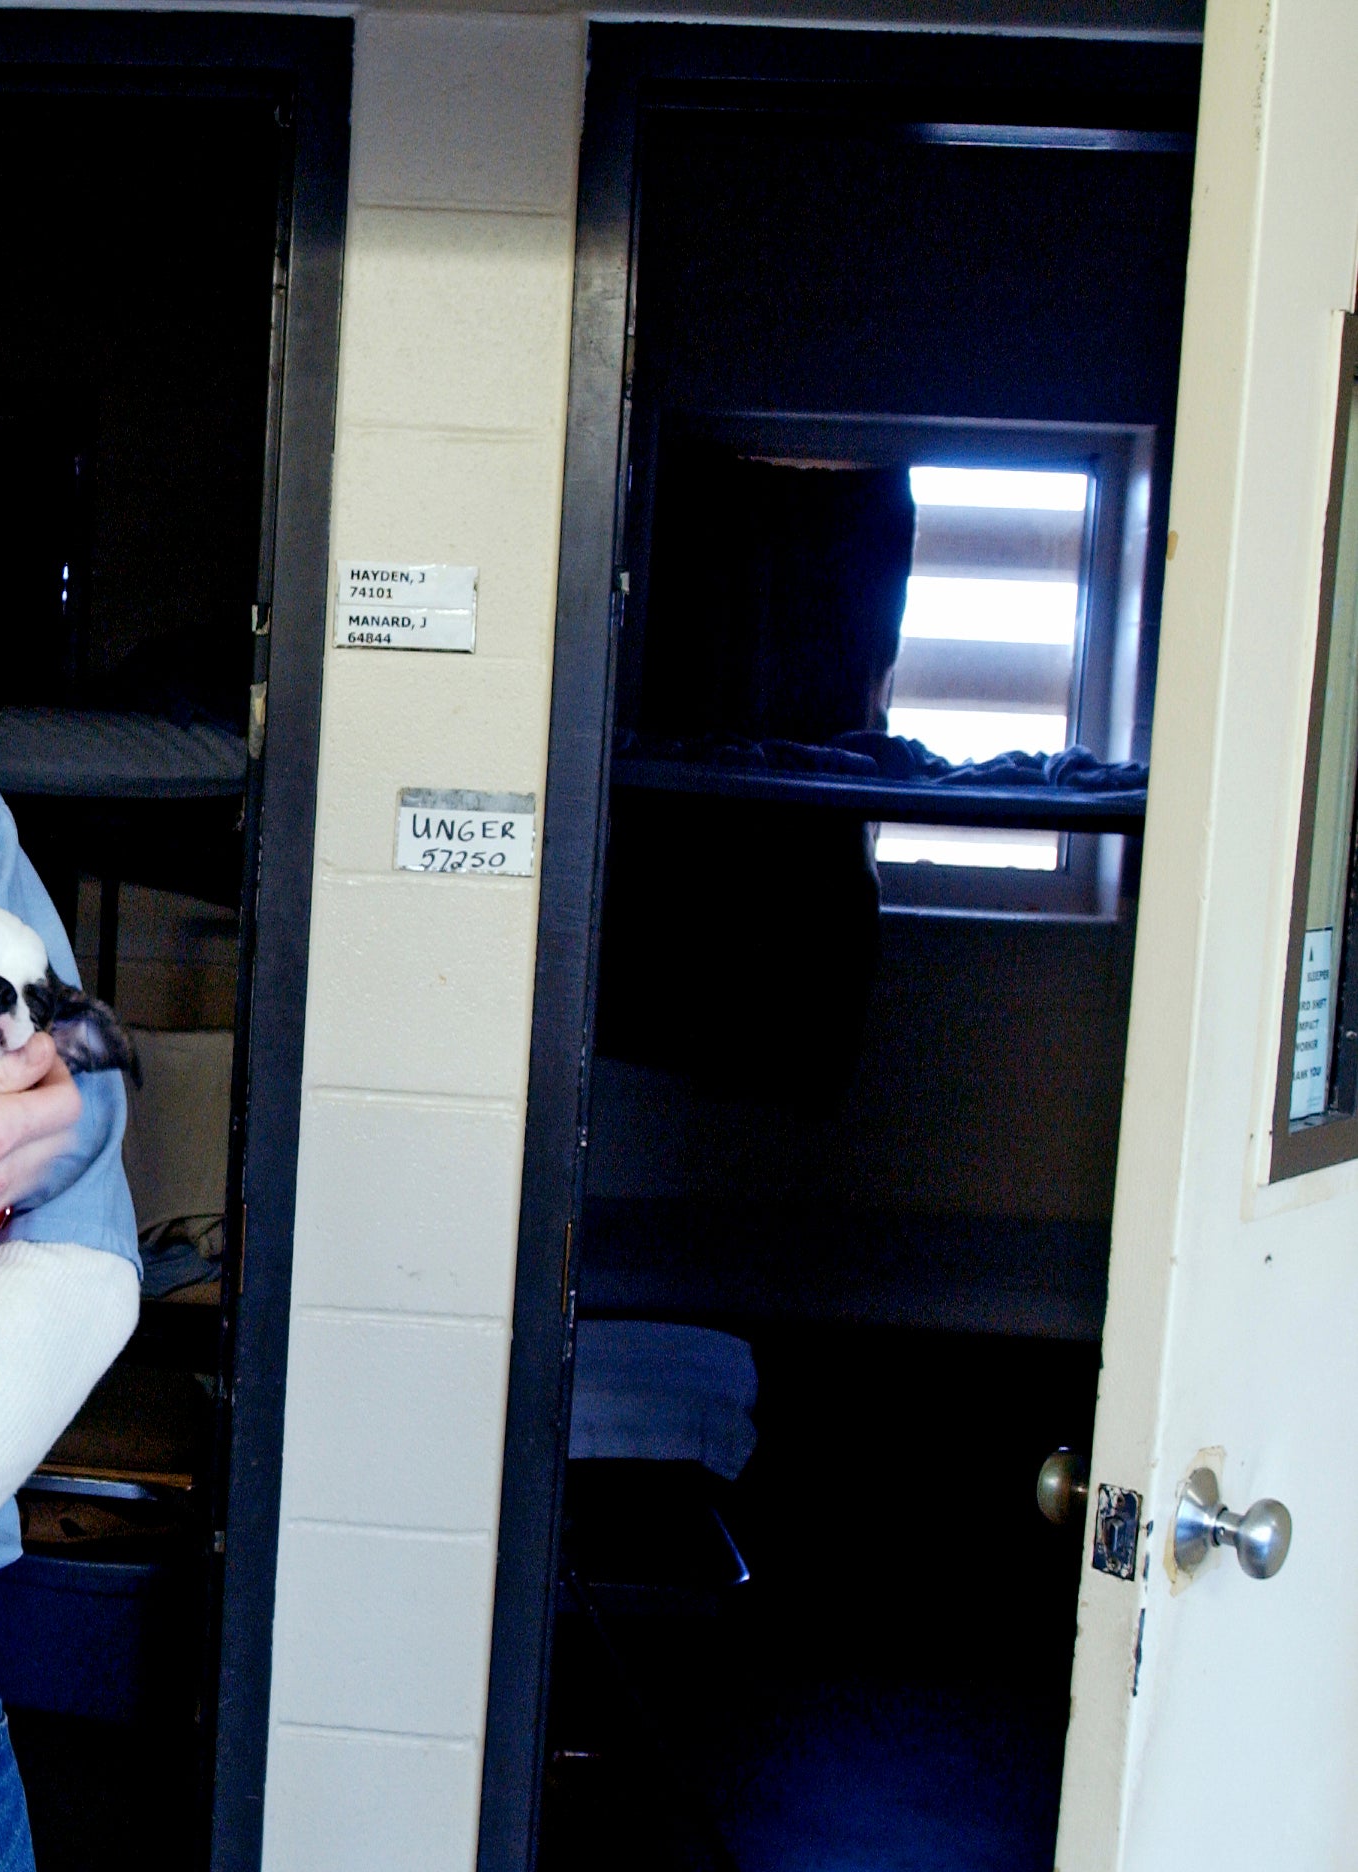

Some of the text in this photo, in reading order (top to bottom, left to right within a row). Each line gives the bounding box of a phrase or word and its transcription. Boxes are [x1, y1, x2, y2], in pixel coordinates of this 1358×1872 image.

[350, 569, 426, 585] HAYDEN, J
[350, 586, 393, 599] 74101
[348, 615, 427, 631] MANARD, J
[348, 632, 392, 645] 64844
[412, 813, 516, 843] UNGER
[419, 848, 507, 873] 57250
